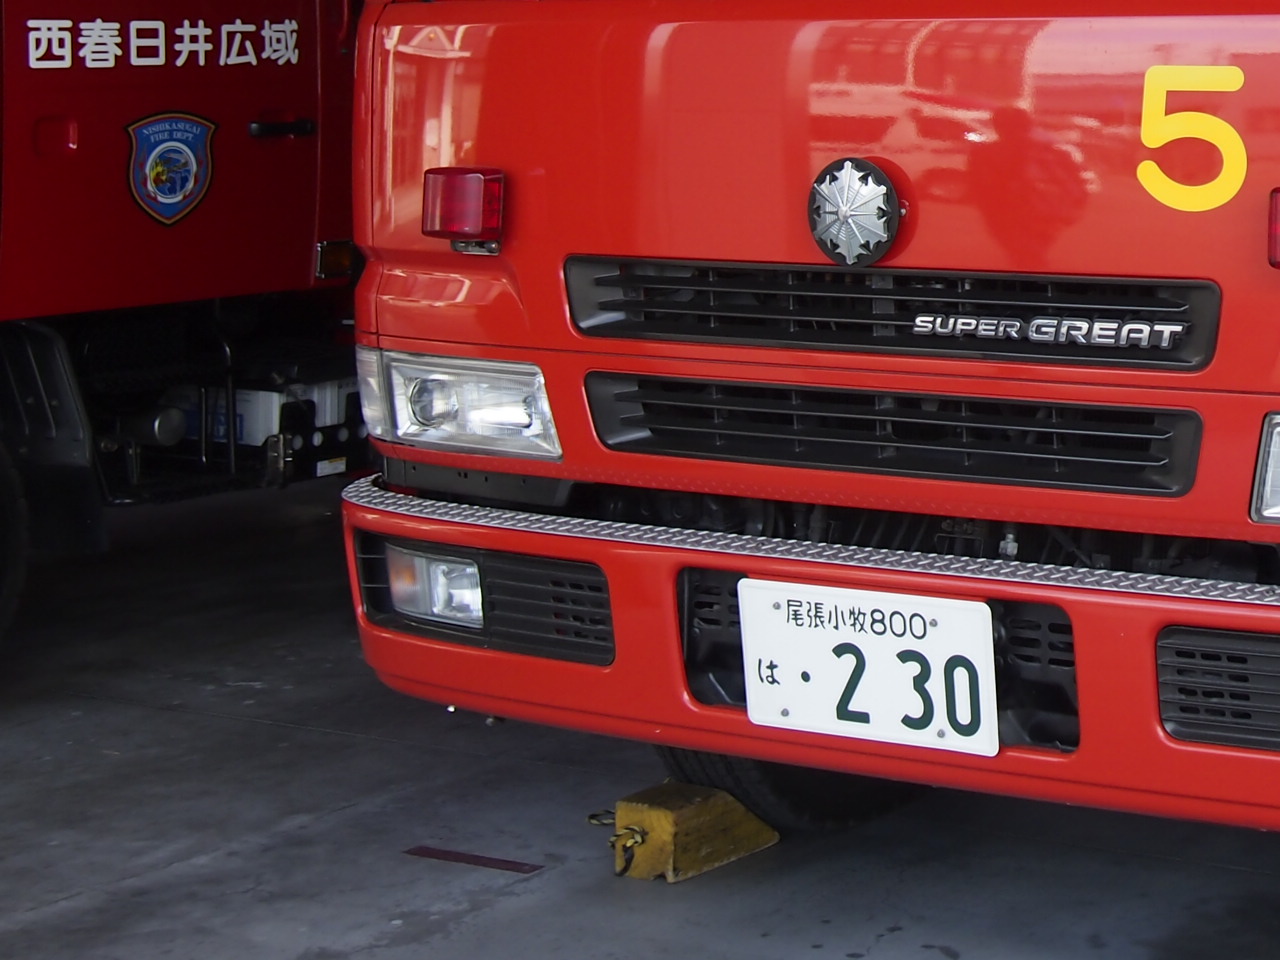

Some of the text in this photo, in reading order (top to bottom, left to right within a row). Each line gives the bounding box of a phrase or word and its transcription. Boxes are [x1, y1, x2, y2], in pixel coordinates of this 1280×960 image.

[26, 18, 300, 69] 西春日井広域
[142, 121, 201, 135] NISHIKASUGAI
[150, 131, 170, 143] FIRE
[1136, 65, 1248, 212] 5
[913, 315, 1184, 348] SUPER GREAT
[757, 658, 781, 686] は
